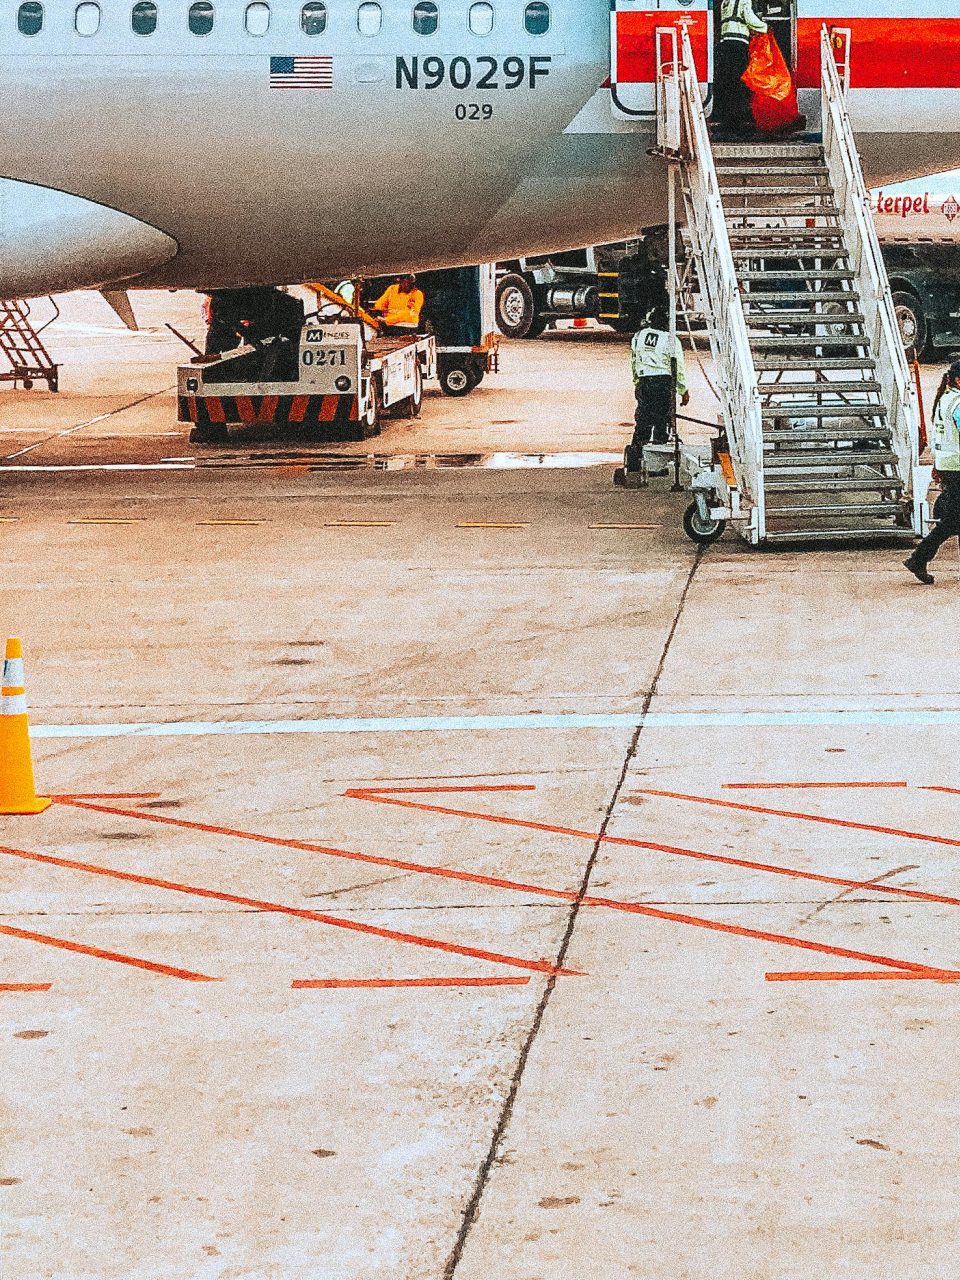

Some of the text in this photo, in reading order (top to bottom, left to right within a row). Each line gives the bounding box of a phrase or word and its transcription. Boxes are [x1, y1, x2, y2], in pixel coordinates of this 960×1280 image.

[396, 56, 551, 89] N9029F
[455, 104, 493, 120] 029
[877, 192, 930, 217] terpel
[645, 334, 657, 346] M
[303, 350, 346, 366] 0271
